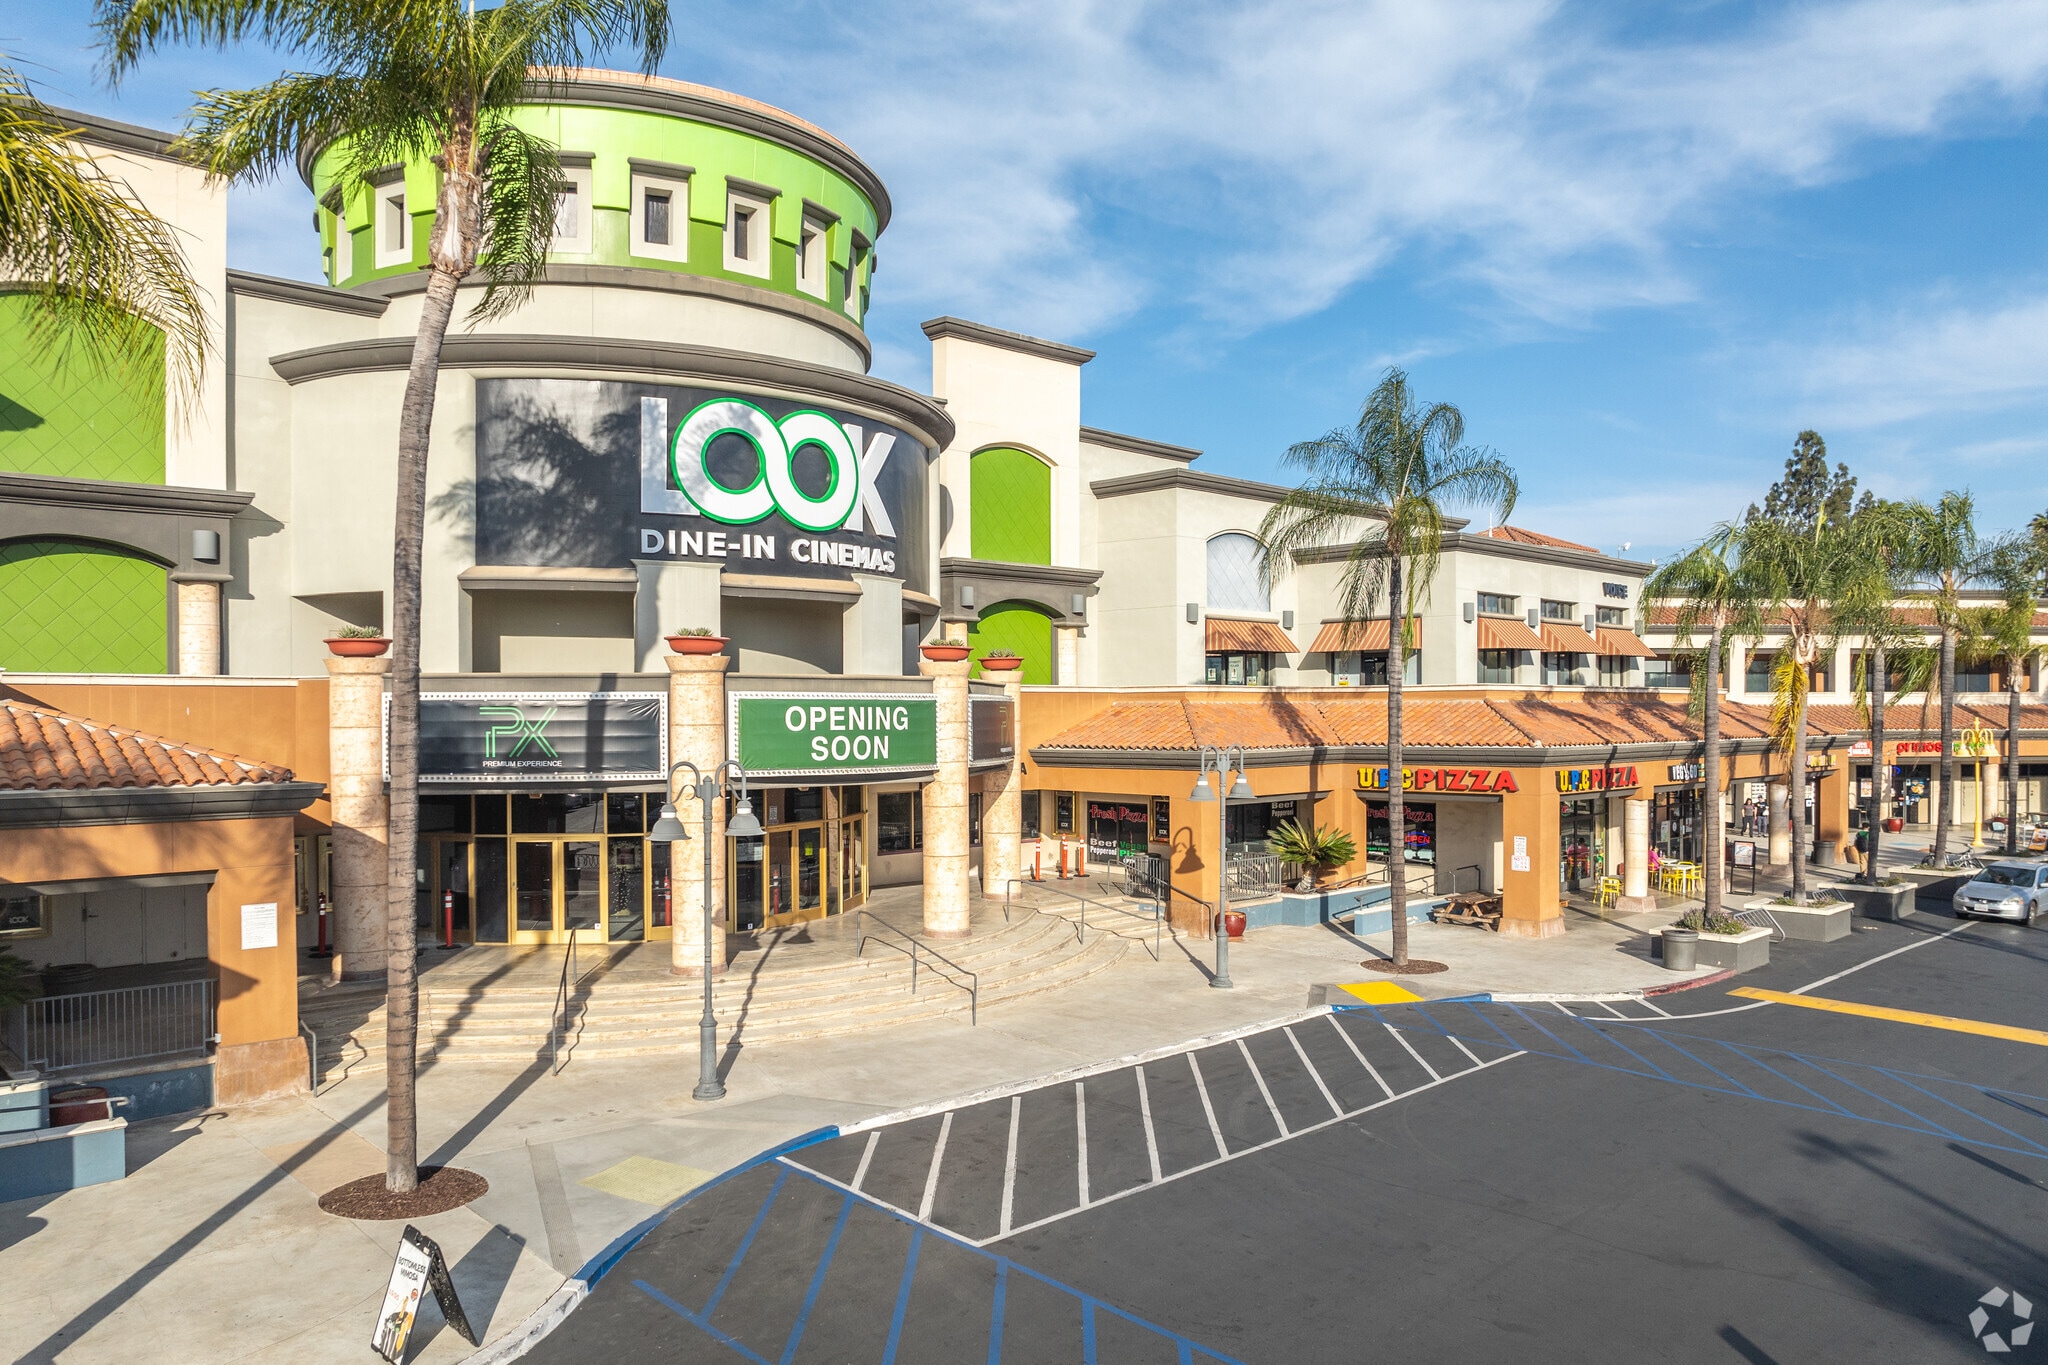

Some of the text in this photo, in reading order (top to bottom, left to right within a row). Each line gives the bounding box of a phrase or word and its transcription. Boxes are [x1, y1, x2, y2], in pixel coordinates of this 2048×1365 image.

[640, 397, 897, 538] LOOK
[640, 528, 896, 573] DINE-IN CINEMAS
[784, 705, 909, 731] OPENING
[479, 706, 559, 758] PX
[811, 735, 889, 761] SOON
[1415, 768, 1519, 792] PIZZA
[1591, 766, 1639, 789] PIZZA
[1090, 804, 1148, 822] Fresh Pizza
[1090, 837, 1118, 848] Beef
[1405, 836, 1430, 844] OPEN
[398, 1256, 426, 1275] BOTTOMLESS
[400, 1267, 419, 1281] MIMOSA
